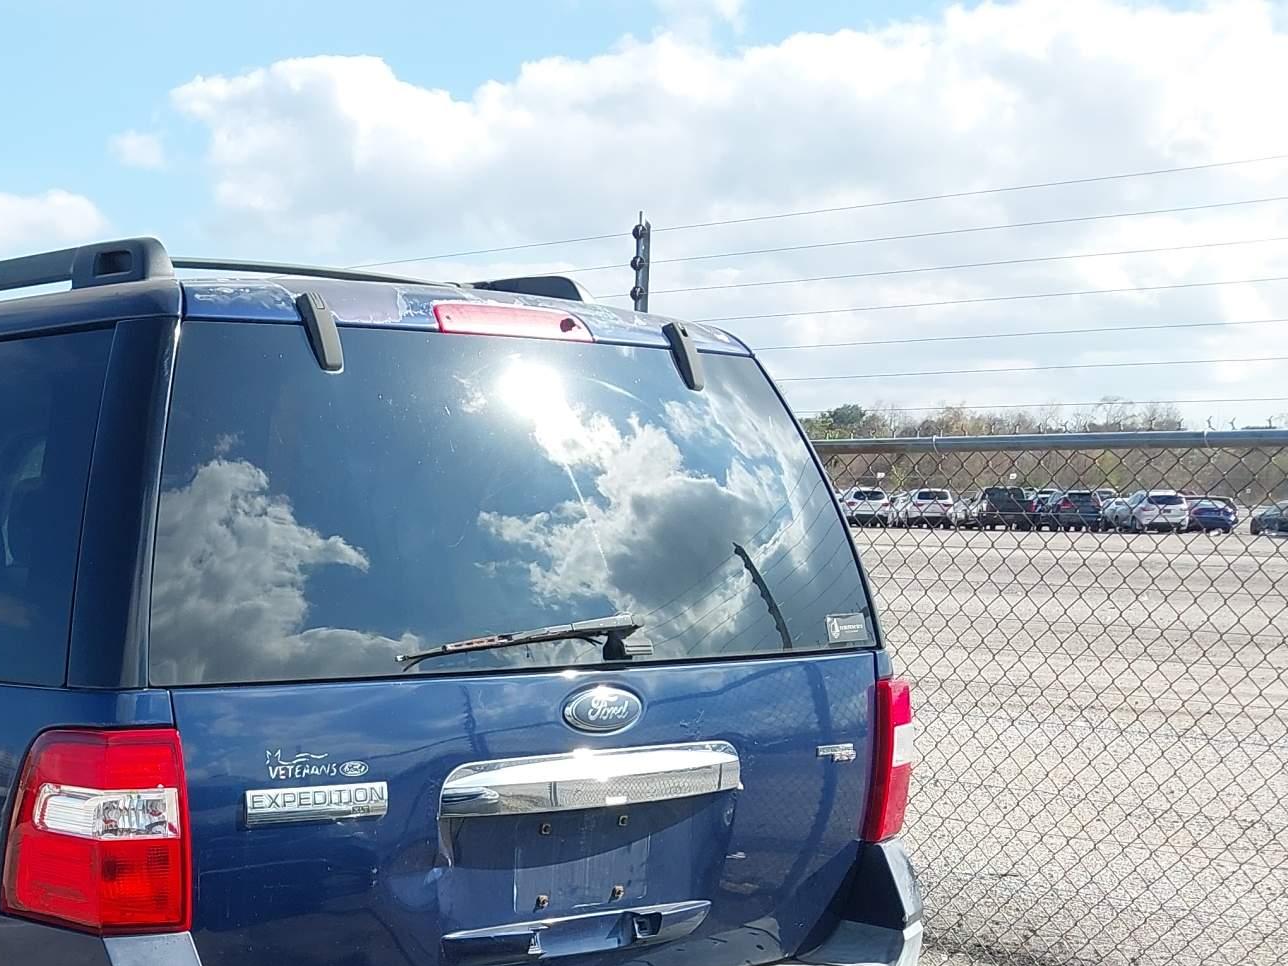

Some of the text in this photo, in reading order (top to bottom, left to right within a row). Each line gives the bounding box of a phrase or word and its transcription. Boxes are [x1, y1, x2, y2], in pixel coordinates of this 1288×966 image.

[587, 693, 629, 721] Ford
[268, 762, 338, 779] VETERANS
[250, 786, 385, 811] EXPEDITION
